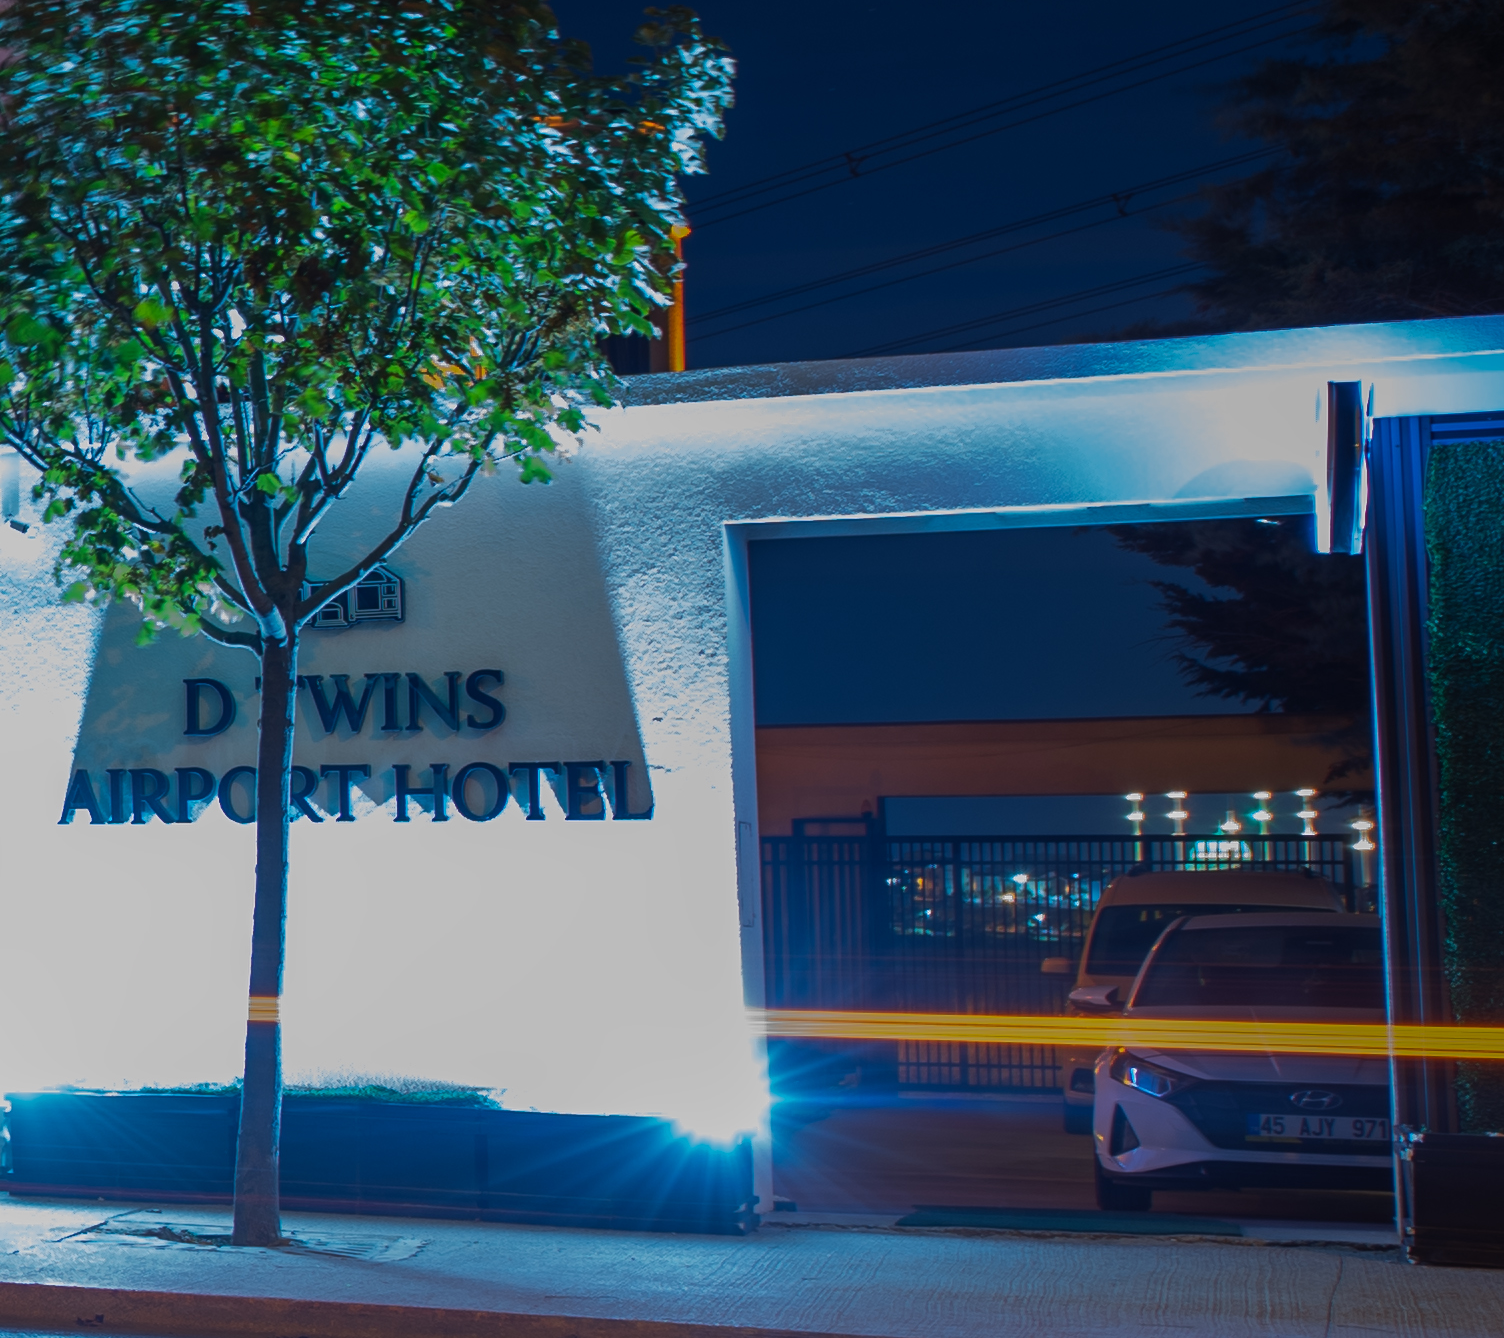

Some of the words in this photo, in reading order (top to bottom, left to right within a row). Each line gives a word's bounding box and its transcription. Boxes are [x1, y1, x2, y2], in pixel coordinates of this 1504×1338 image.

[182, 677, 237, 738] D
[254, 668, 507, 736] WINS
[56, 763, 372, 825] AIRPORT
[390, 759, 655, 823] HOTEL
[1260, 1115, 1286, 1136] 45
[1299, 1117, 1336, 1137] AJY
[1351, 1119, 1388, 1139] 971
